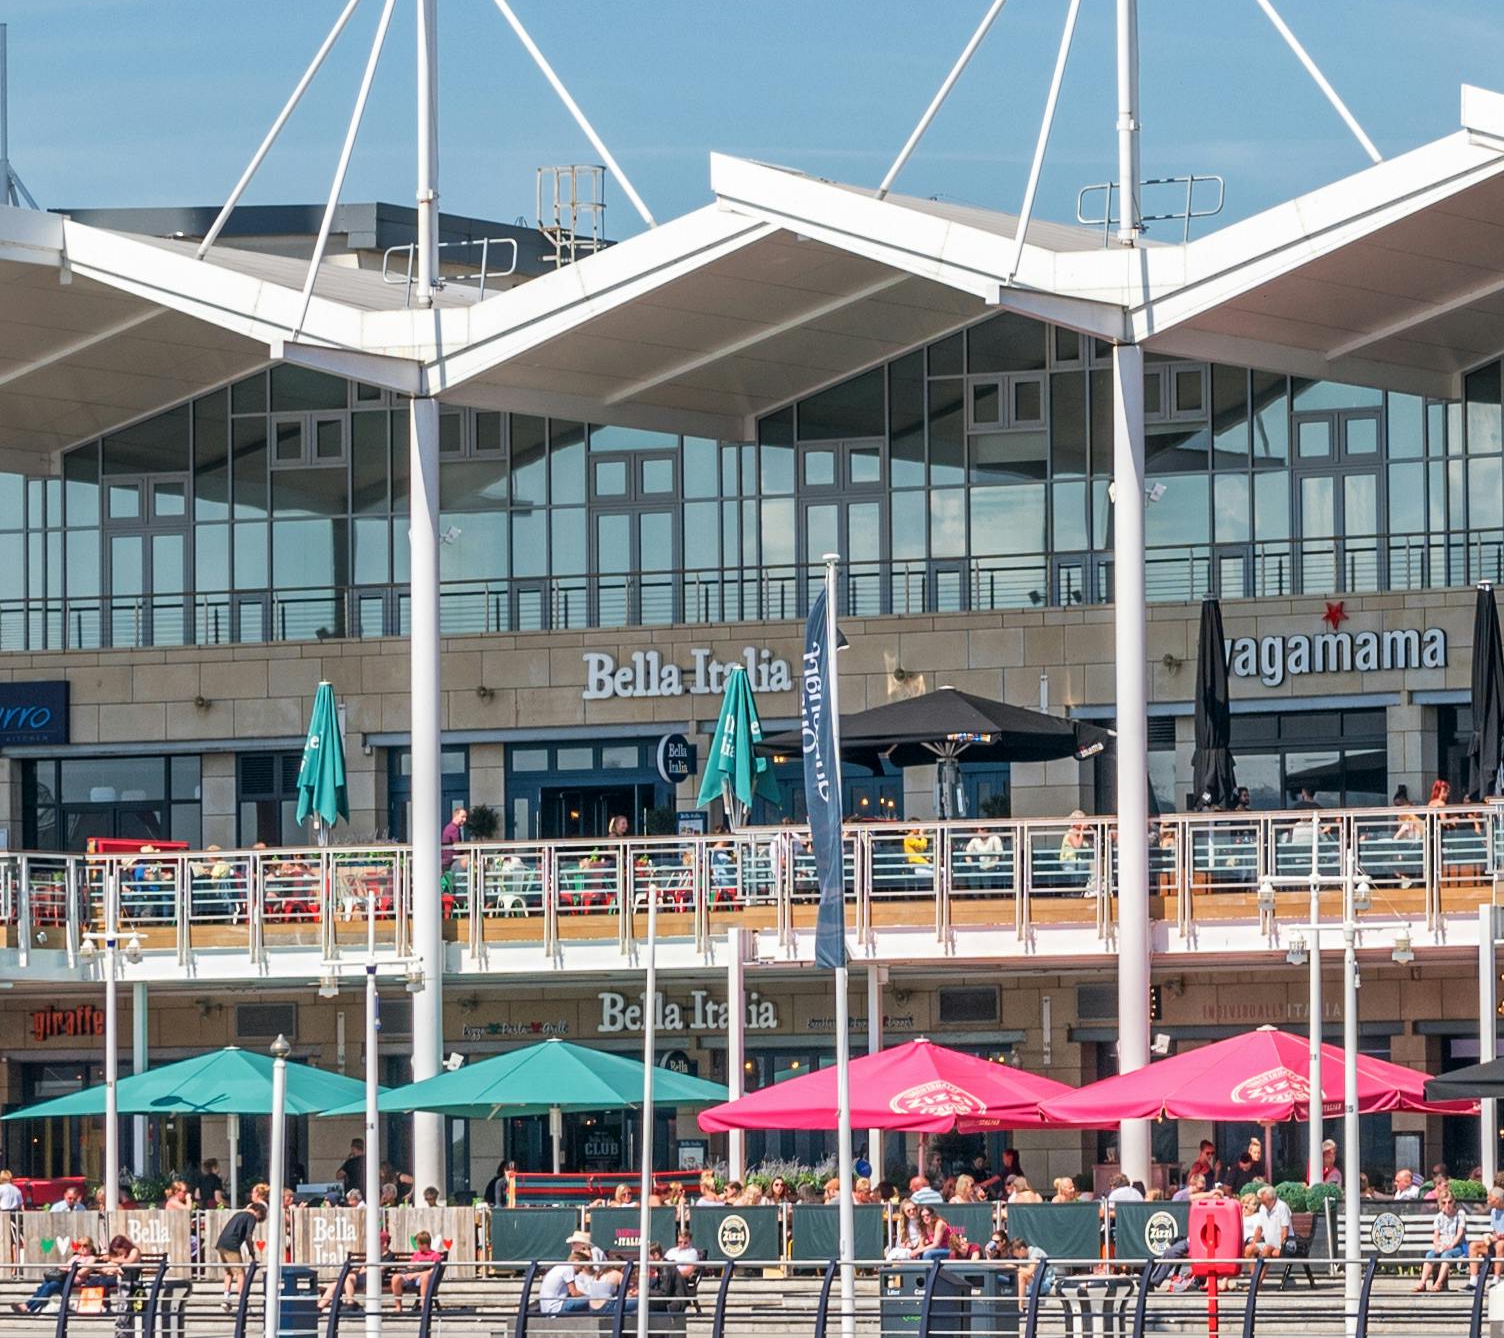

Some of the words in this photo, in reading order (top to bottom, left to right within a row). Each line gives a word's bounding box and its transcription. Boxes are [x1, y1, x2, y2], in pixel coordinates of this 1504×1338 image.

[1226, 626, 1446, 687] agamama
[582, 653, 683, 700] Bella
[668, 743, 688, 758] Bella
[32, 1004, 105, 1042] giraffe
[689, 990, 778, 1029] Itaia
[127, 1218, 171, 1244] Bella
[314, 1216, 358, 1242] Bella
